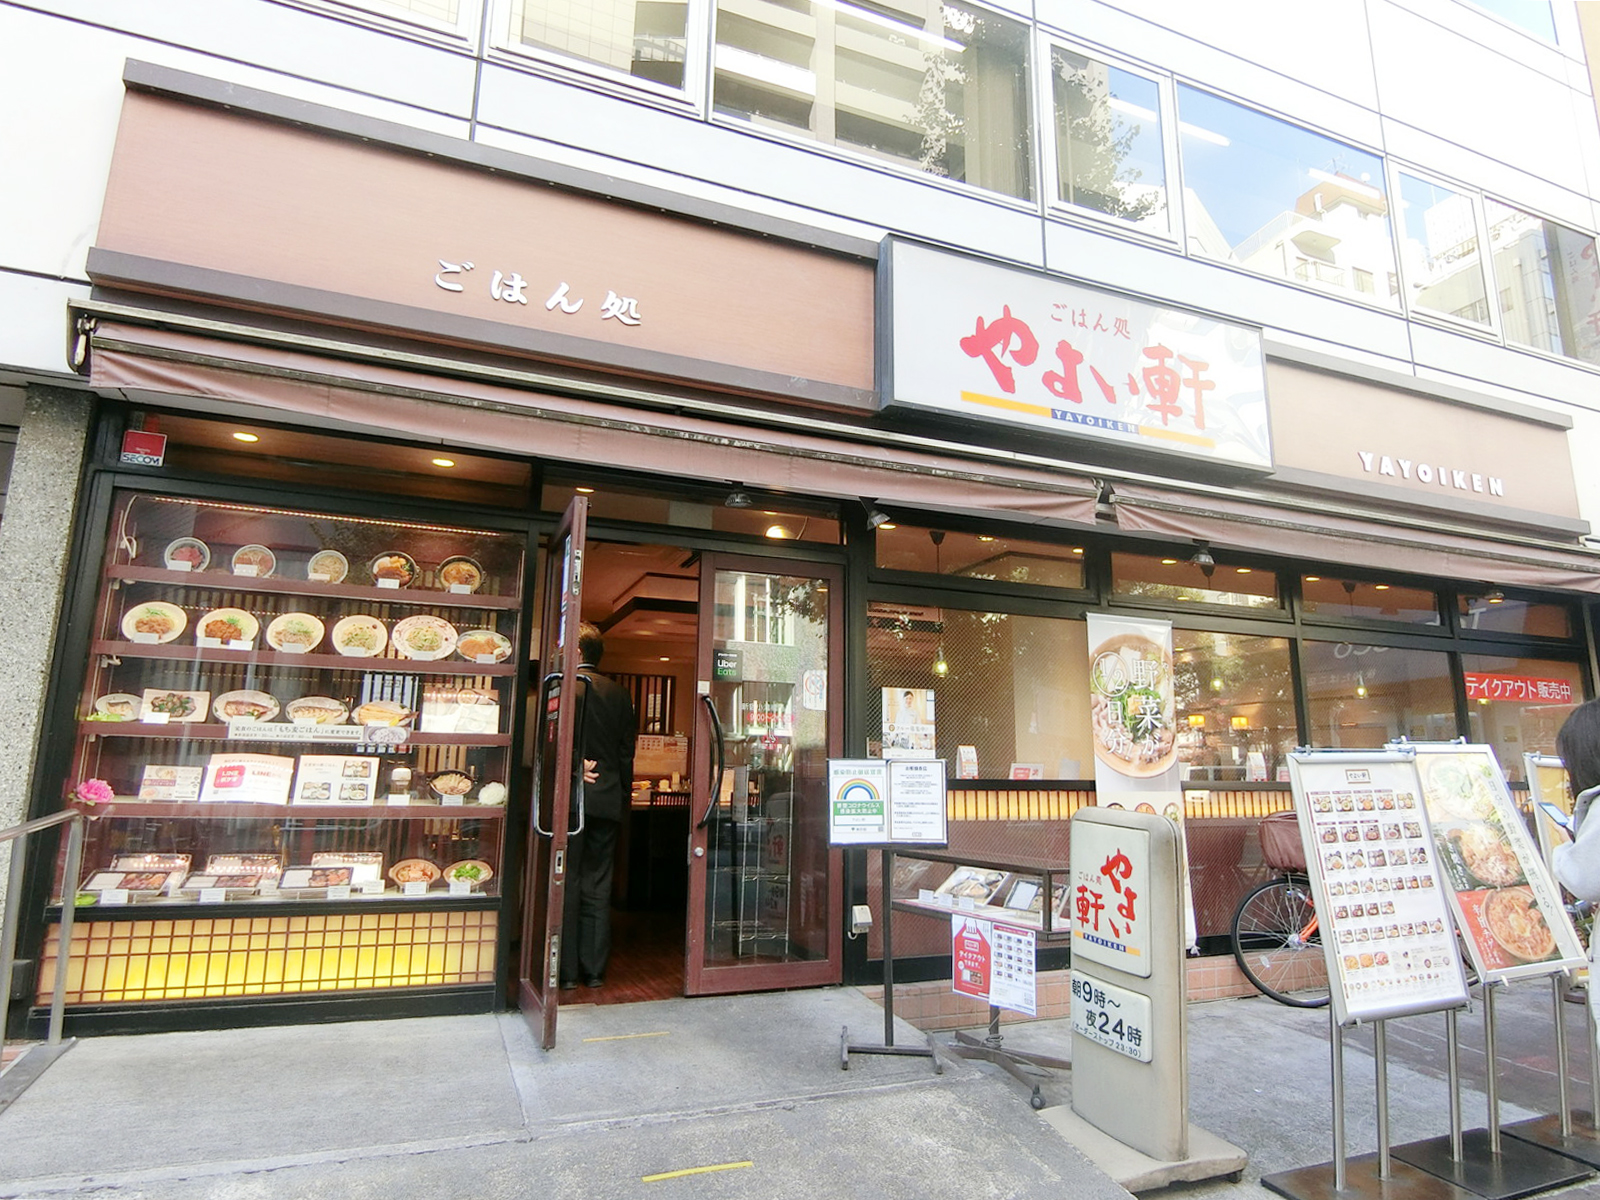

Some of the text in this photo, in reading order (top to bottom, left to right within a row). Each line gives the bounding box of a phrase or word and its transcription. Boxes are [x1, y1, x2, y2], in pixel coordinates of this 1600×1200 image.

[435, 258, 642, 326] ごはん処
[1050, 302, 1131, 340] ごはん処
[959, 304, 1216, 430] やよい軒
[1052, 409, 1138, 434] YAYOIKEN
[122, 453, 160, 466] SECOM
[1358, 451, 1504, 497] YAYOIKEN
[717, 659, 737, 668] Uber
[717, 667, 737, 676] Eats
[1465, 676, 1572, 700] テイクアウト販売中
[1132, 658, 1164, 756] 野菜が
[1083, 932, 1126, 952] YAYOIKEN
[958, 949, 986, 963] テイクアウト
[1085, 1009, 1142, 1047] 夜24時
